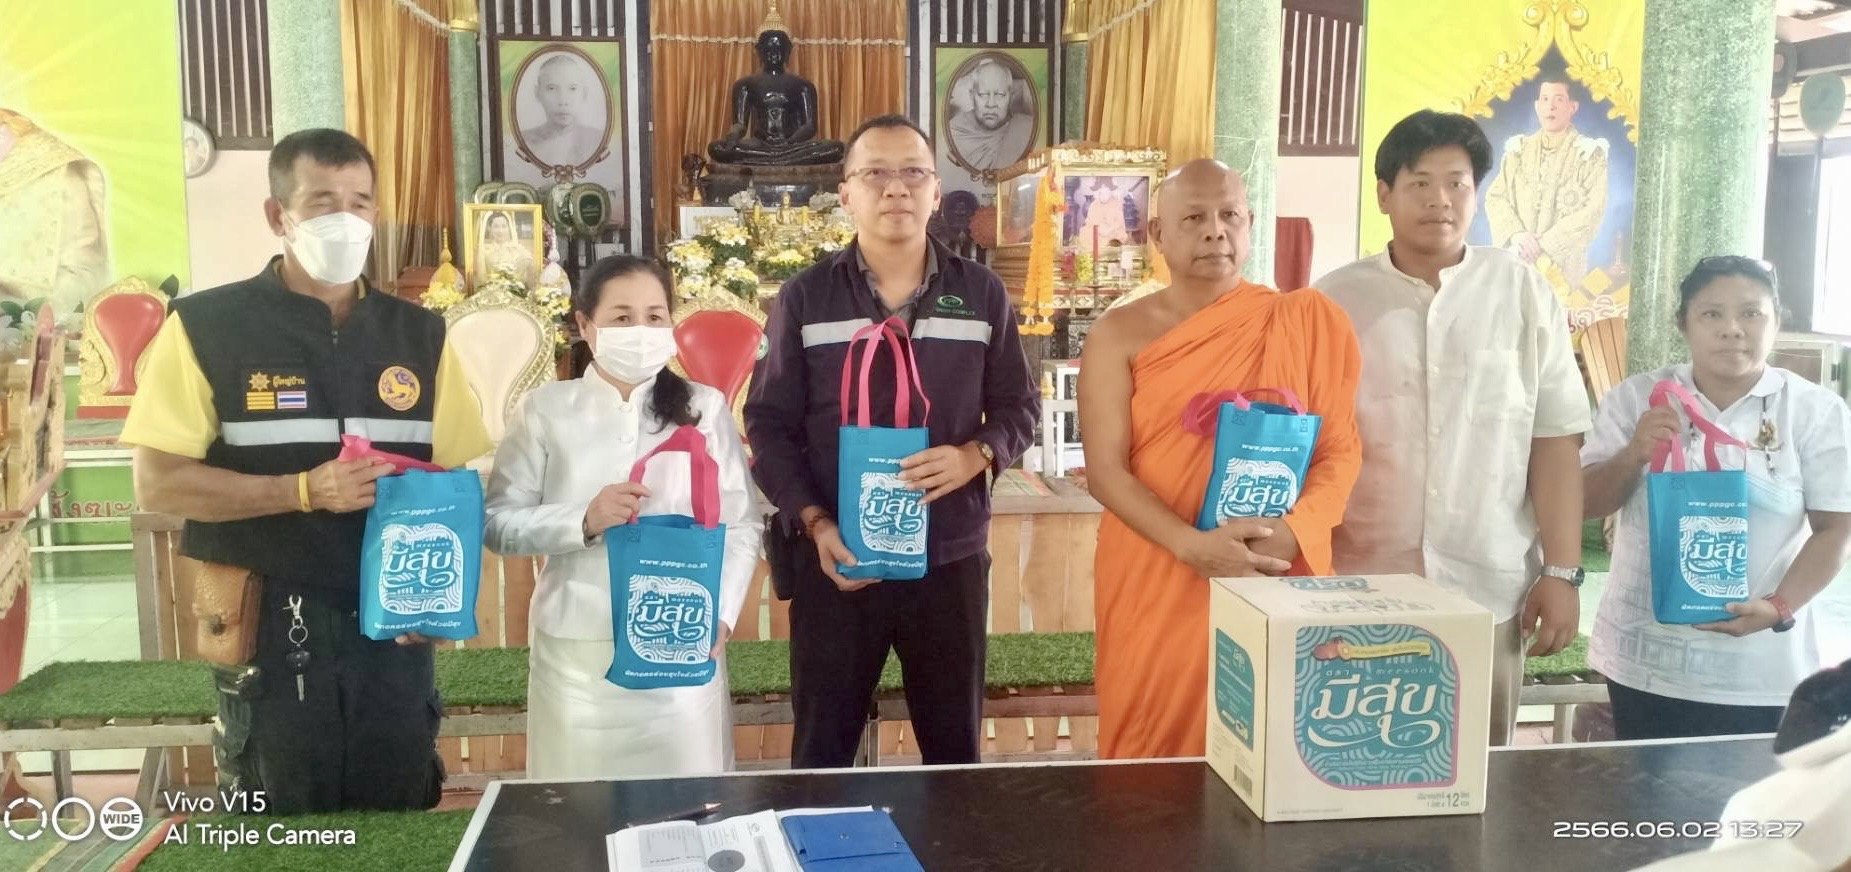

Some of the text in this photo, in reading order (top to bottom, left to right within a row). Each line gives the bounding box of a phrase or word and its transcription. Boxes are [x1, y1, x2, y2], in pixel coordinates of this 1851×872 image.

[864, 494, 923, 533] มีสุข
[1224, 481, 1289, 517] มีสุข
[384, 547, 457, 588] มีสุข
[634, 598, 705, 641] มีสุข
[1307, 674, 1441, 749] มีสุข
[1446, 792, 1460, 807] 12
